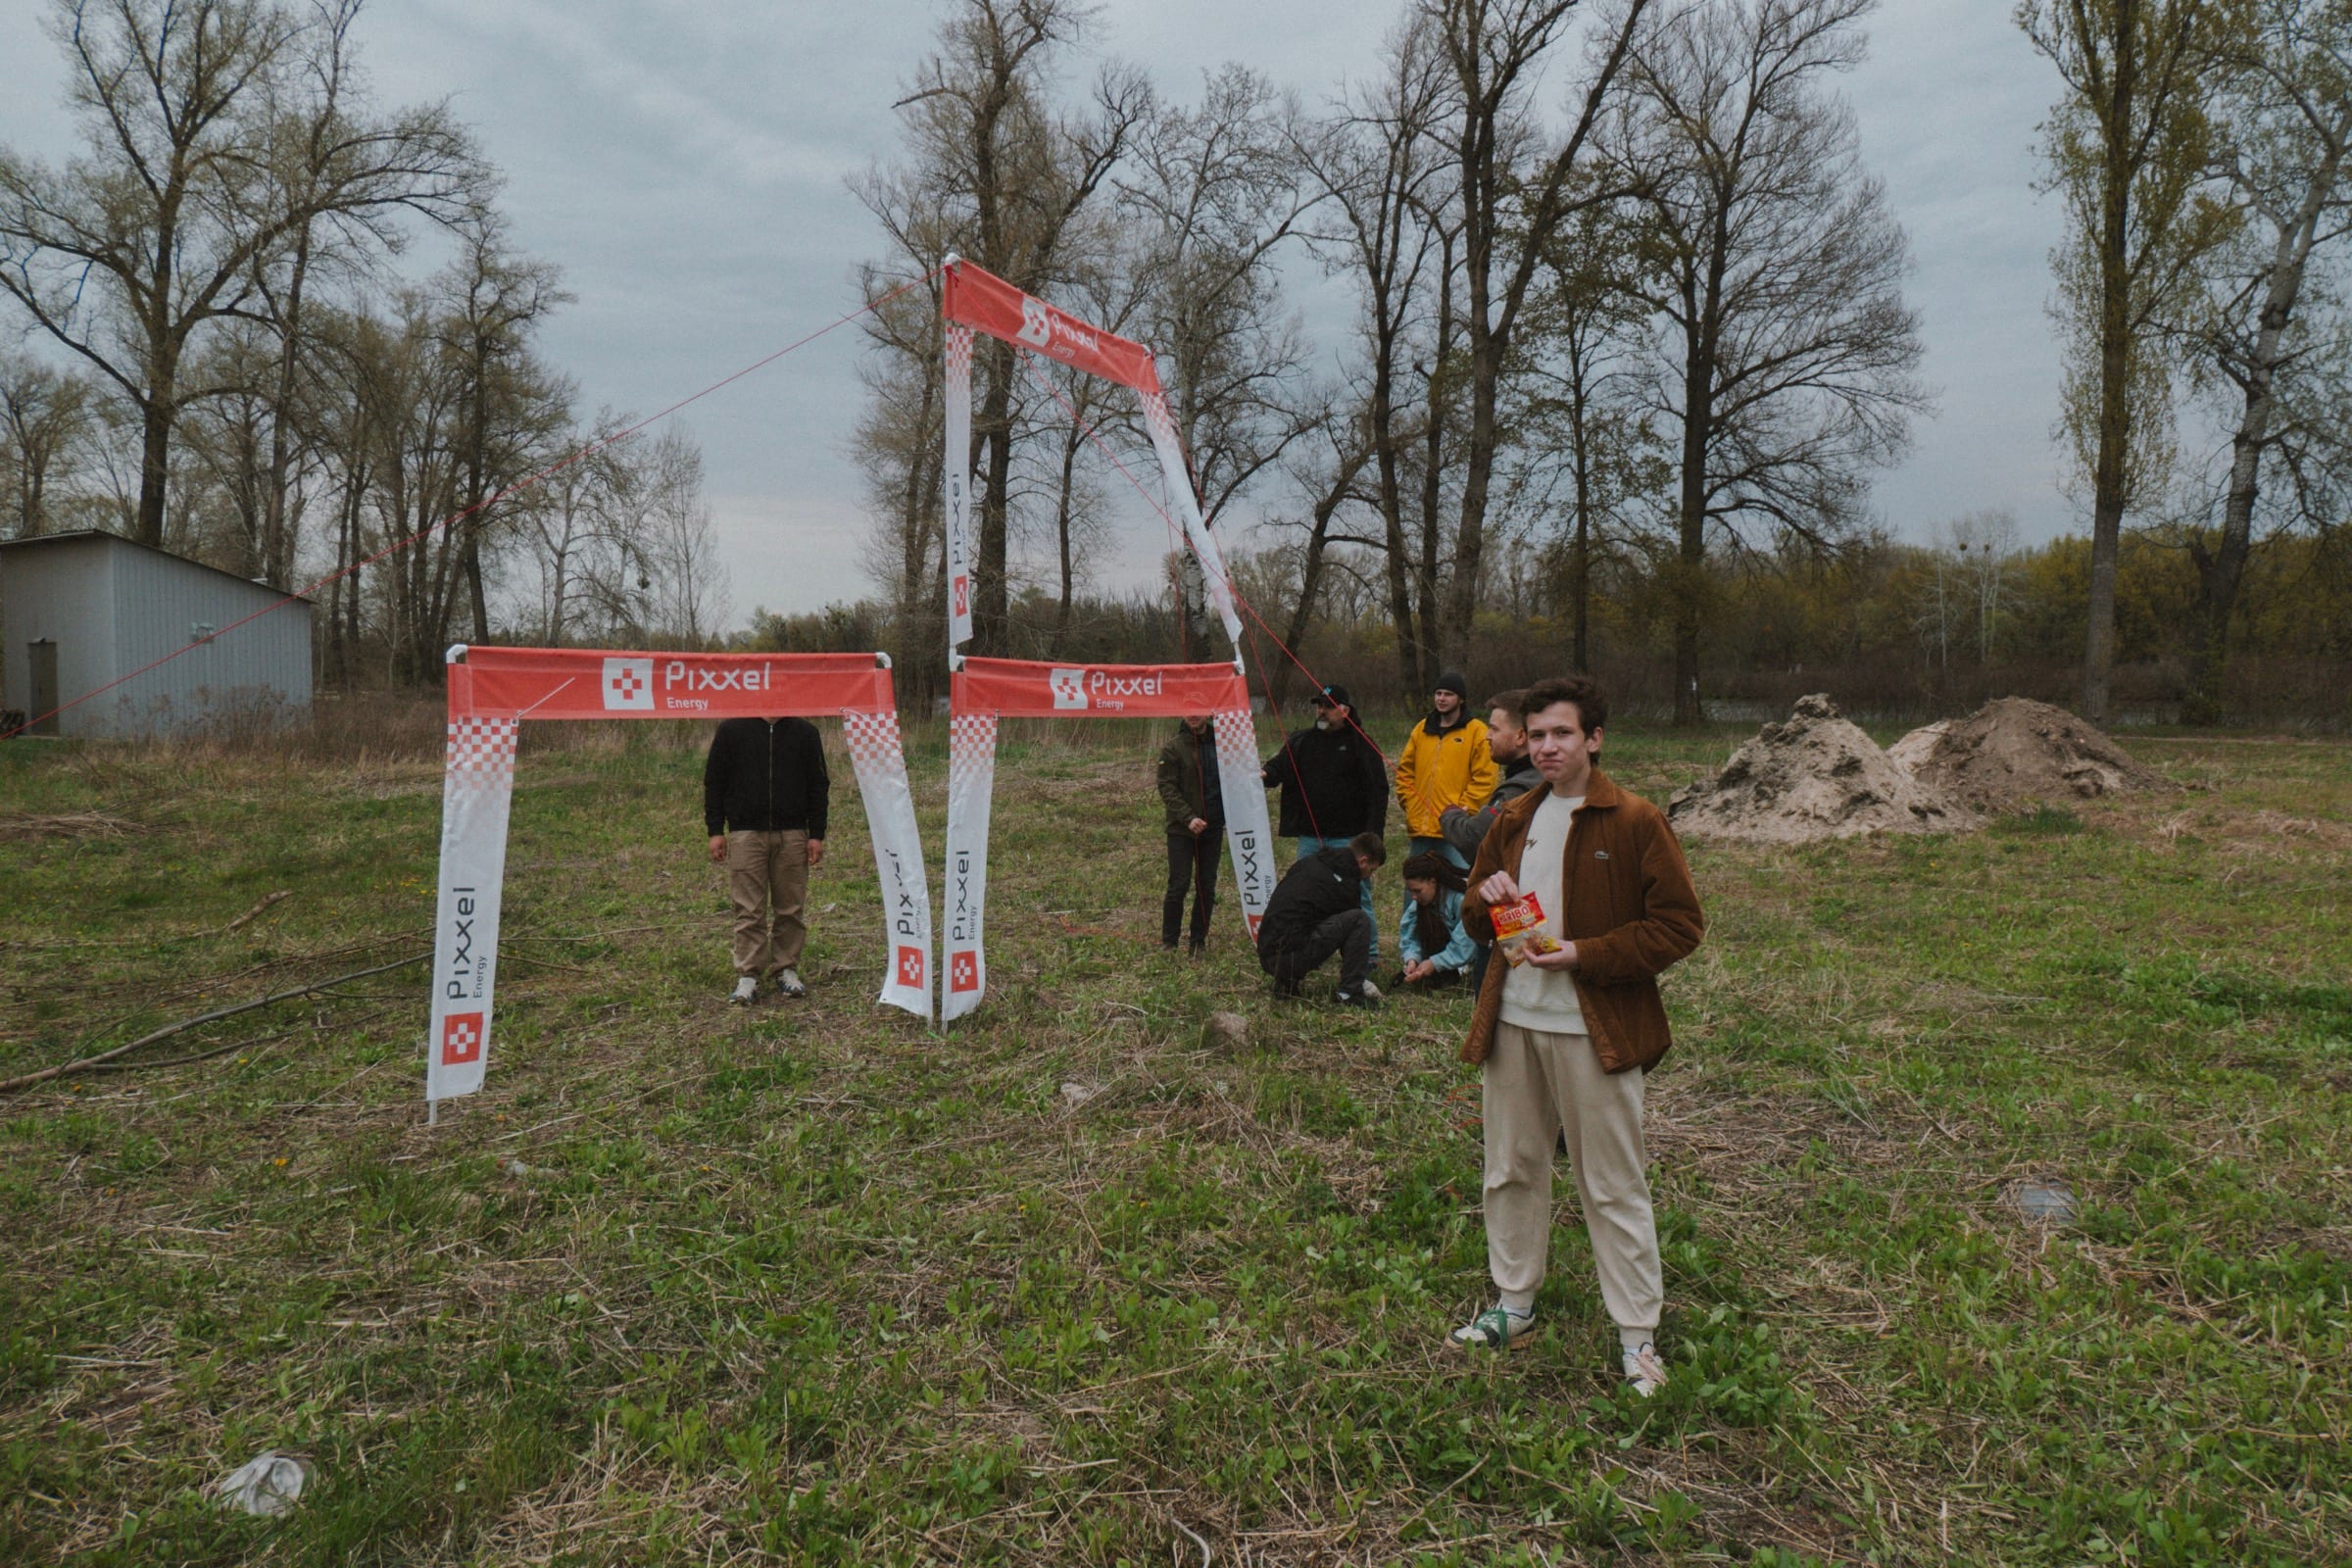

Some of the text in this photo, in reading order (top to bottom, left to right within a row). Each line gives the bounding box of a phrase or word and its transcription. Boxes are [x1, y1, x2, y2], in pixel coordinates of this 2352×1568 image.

[665, 661, 771, 691] Pixxel
[1091, 671, 1162, 696] Pixxel
[666, 697, 709, 711] Energy
[1096, 698, 1124, 711] Energy
[1234, 830, 1261, 906] Pixxel
[953, 850, 969, 941] Pixxel
[446, 887, 475, 1000] Pixxel
[472, 956, 488, 999] Energy
